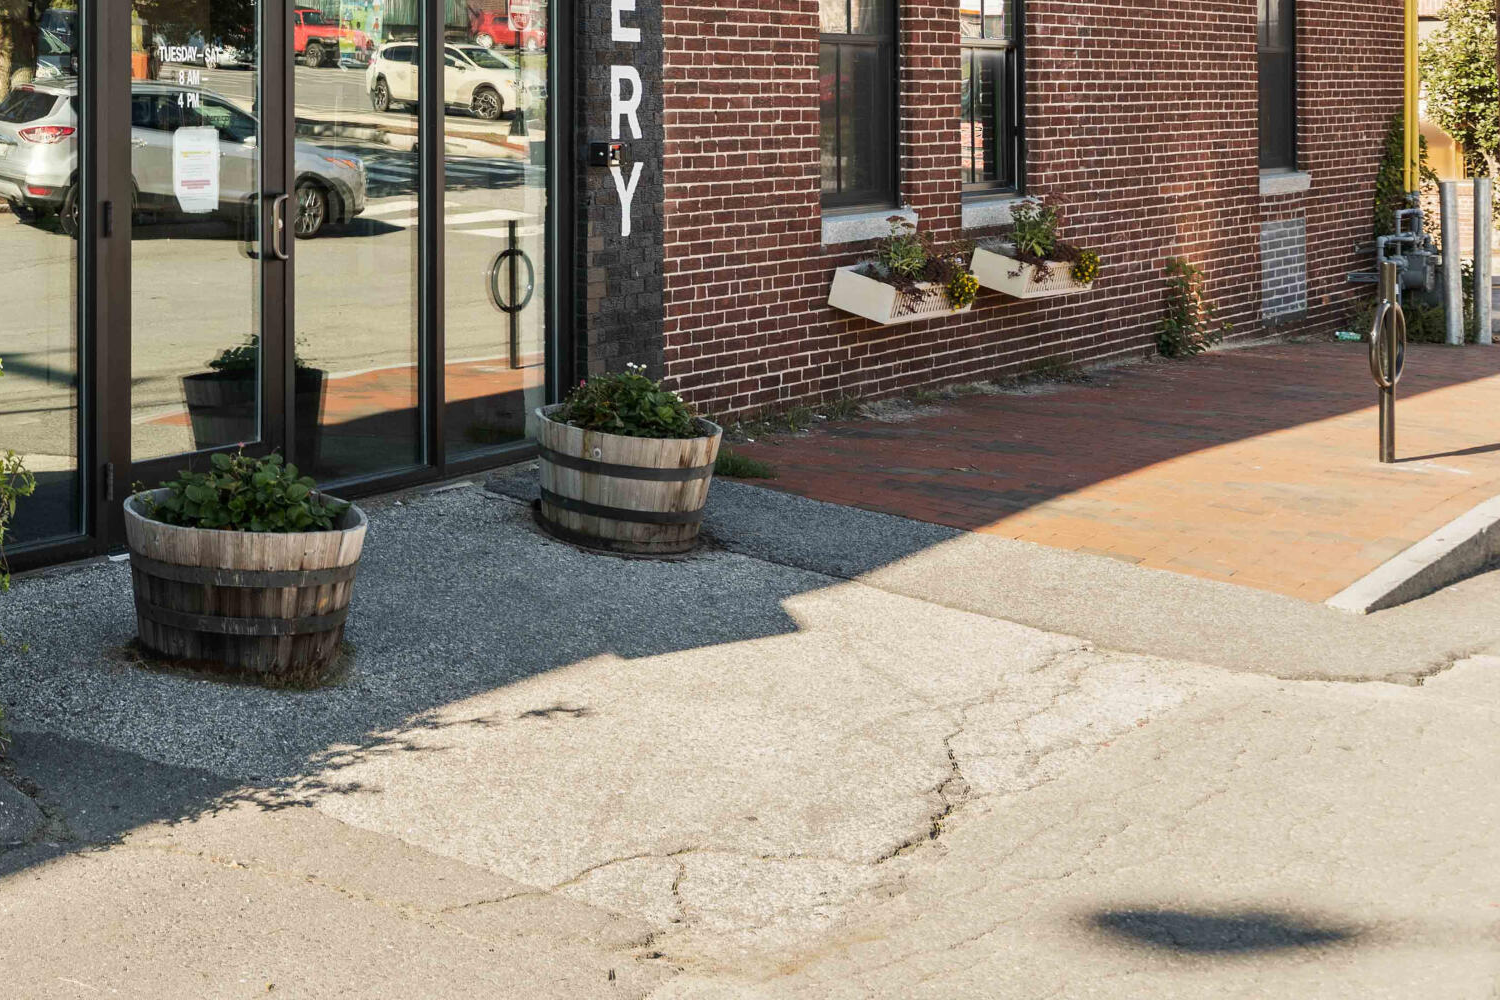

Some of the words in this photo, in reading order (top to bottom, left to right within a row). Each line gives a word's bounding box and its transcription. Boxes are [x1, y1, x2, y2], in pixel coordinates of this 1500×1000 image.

[178, 70, 185, 85] 8
[186, 70, 200, 85] AM
[177, 93, 184, 108] 4
[186, 93, 200, 108] PM
